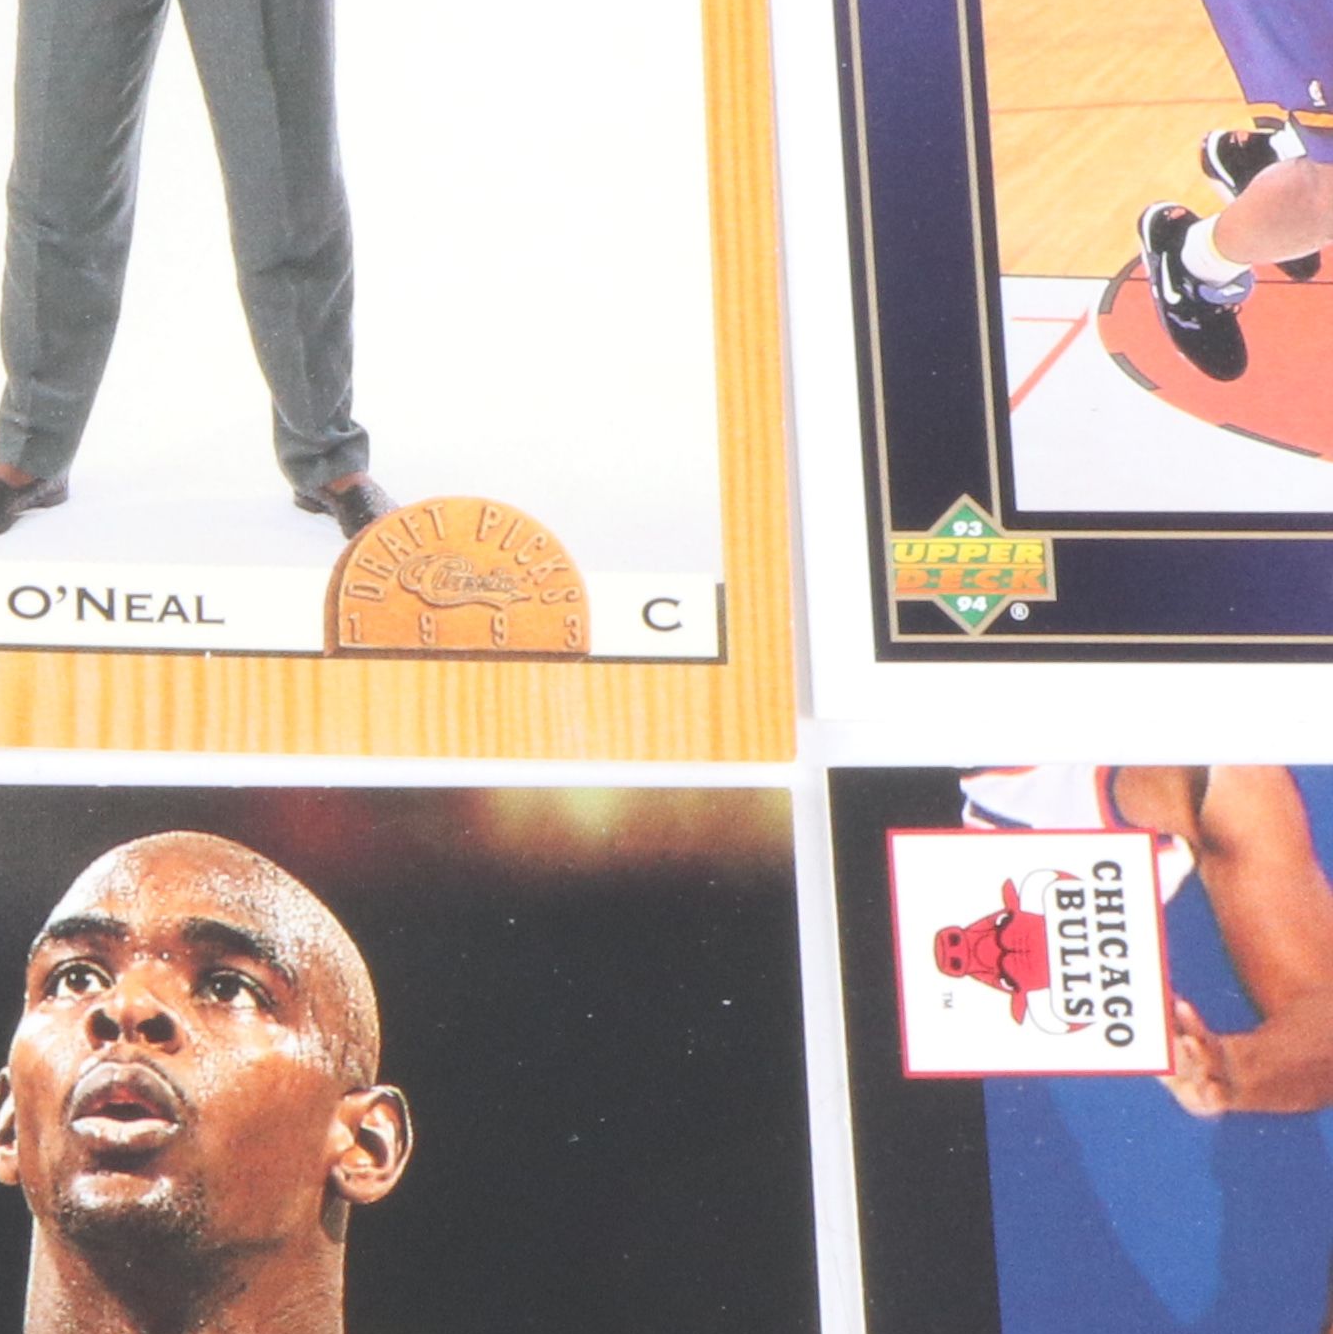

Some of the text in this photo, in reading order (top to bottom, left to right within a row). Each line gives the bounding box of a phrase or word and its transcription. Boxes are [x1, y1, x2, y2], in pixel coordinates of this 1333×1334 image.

[951, 520, 983, 538] 93
[345, 502, 583, 605] DRAFT PICKS
[893, 542, 1044, 564] UPPER
[641, 596, 684, 633] C
[956, 596, 988, 612] 94
[1054, 886, 1095, 1019] BULLS
[1090, 860, 1135, 1049] CHICAGO
